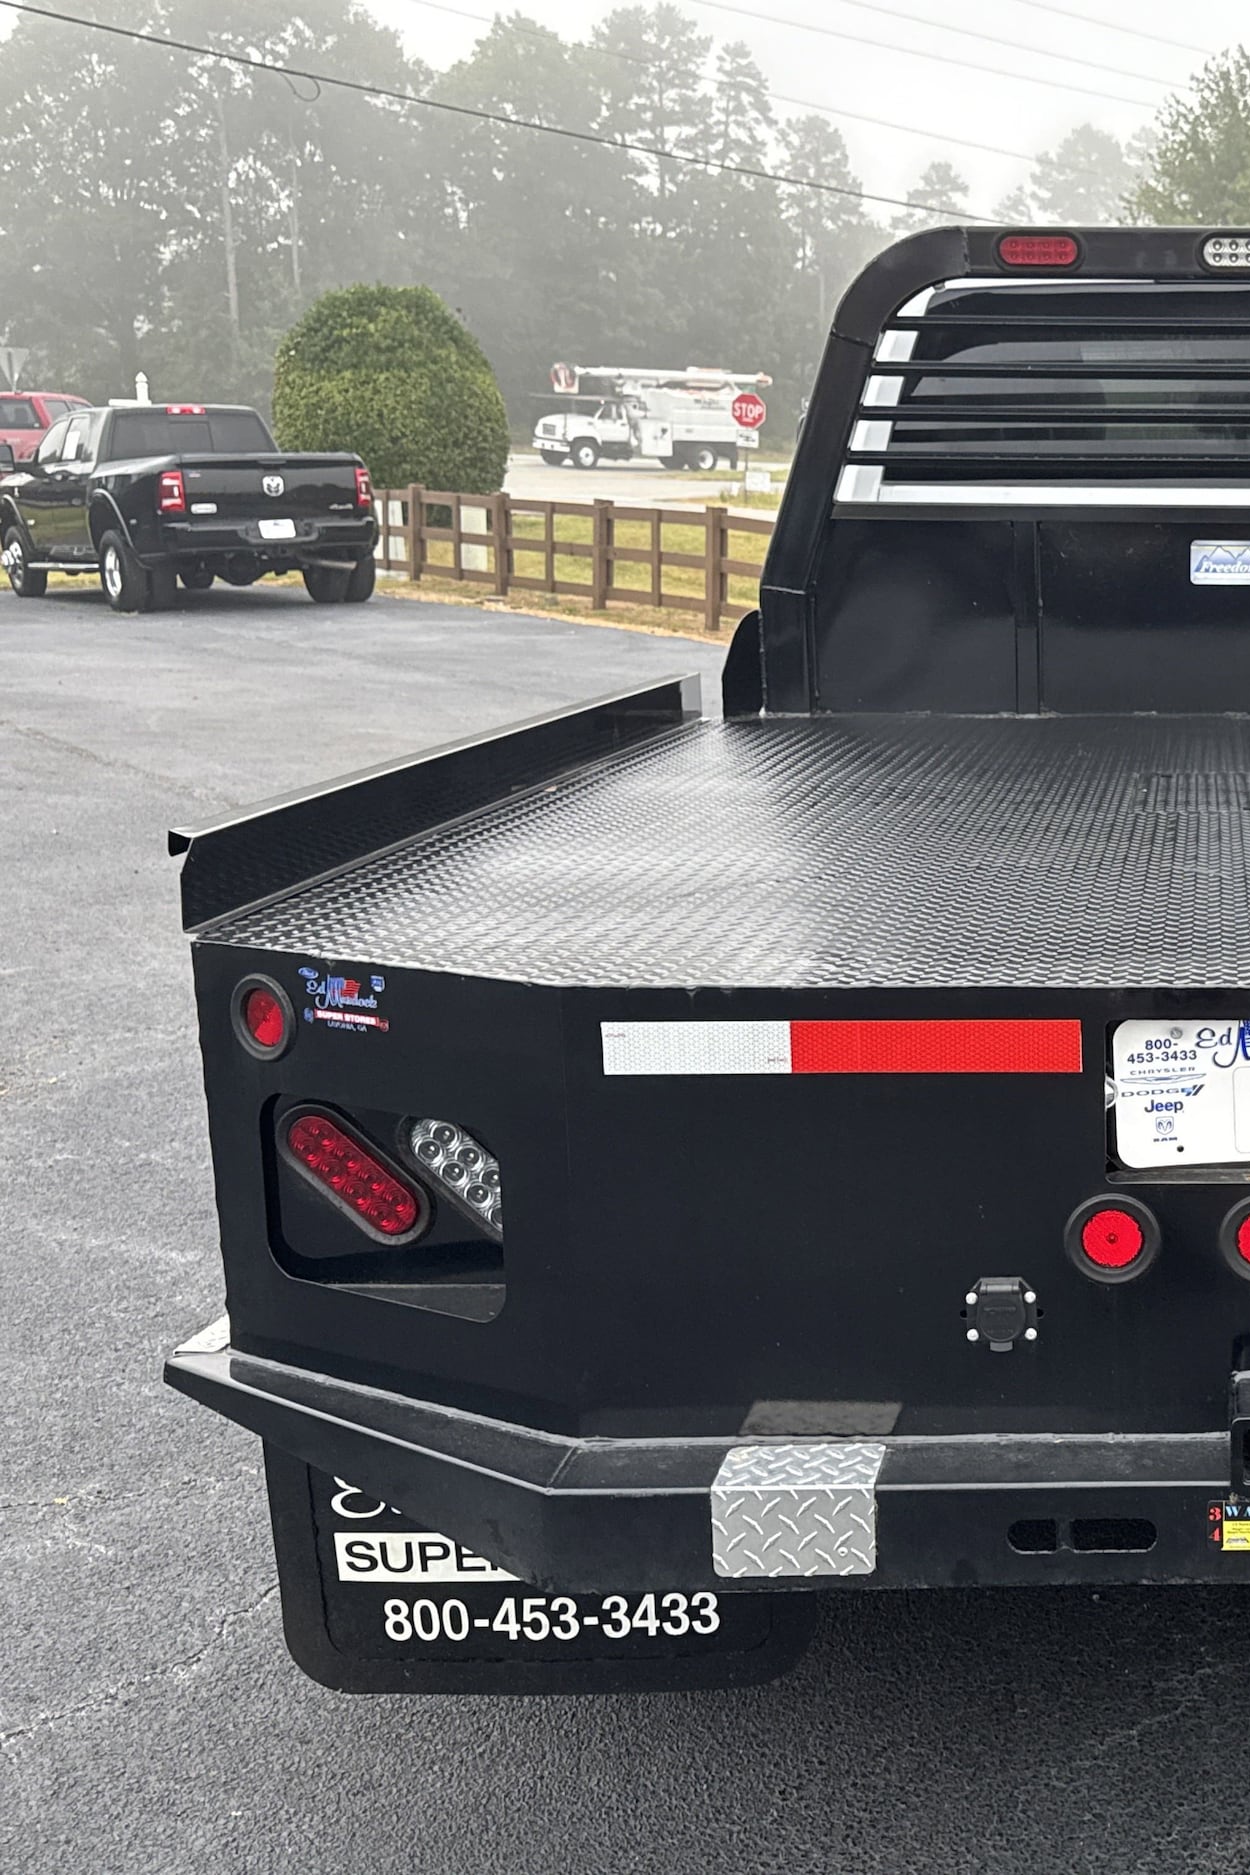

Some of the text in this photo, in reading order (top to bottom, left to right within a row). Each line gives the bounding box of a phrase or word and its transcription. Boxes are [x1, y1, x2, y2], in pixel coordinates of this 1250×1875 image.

[733, 402, 764, 419] STOP
[344, 1013, 376, 1025] STORES
[1144, 1038, 1179, 1051] 800-
[1194, 1027, 1233, 1049] Ed
[1127, 1050, 1198, 1065] 453-3433
[1130, 1066, 1196, 1076] CHRYSLER
[1144, 1099, 1184, 1114] Jeep
[345, 1540, 499, 1573] SUPE
[383, 1591, 721, 1641] 800-453-3433
